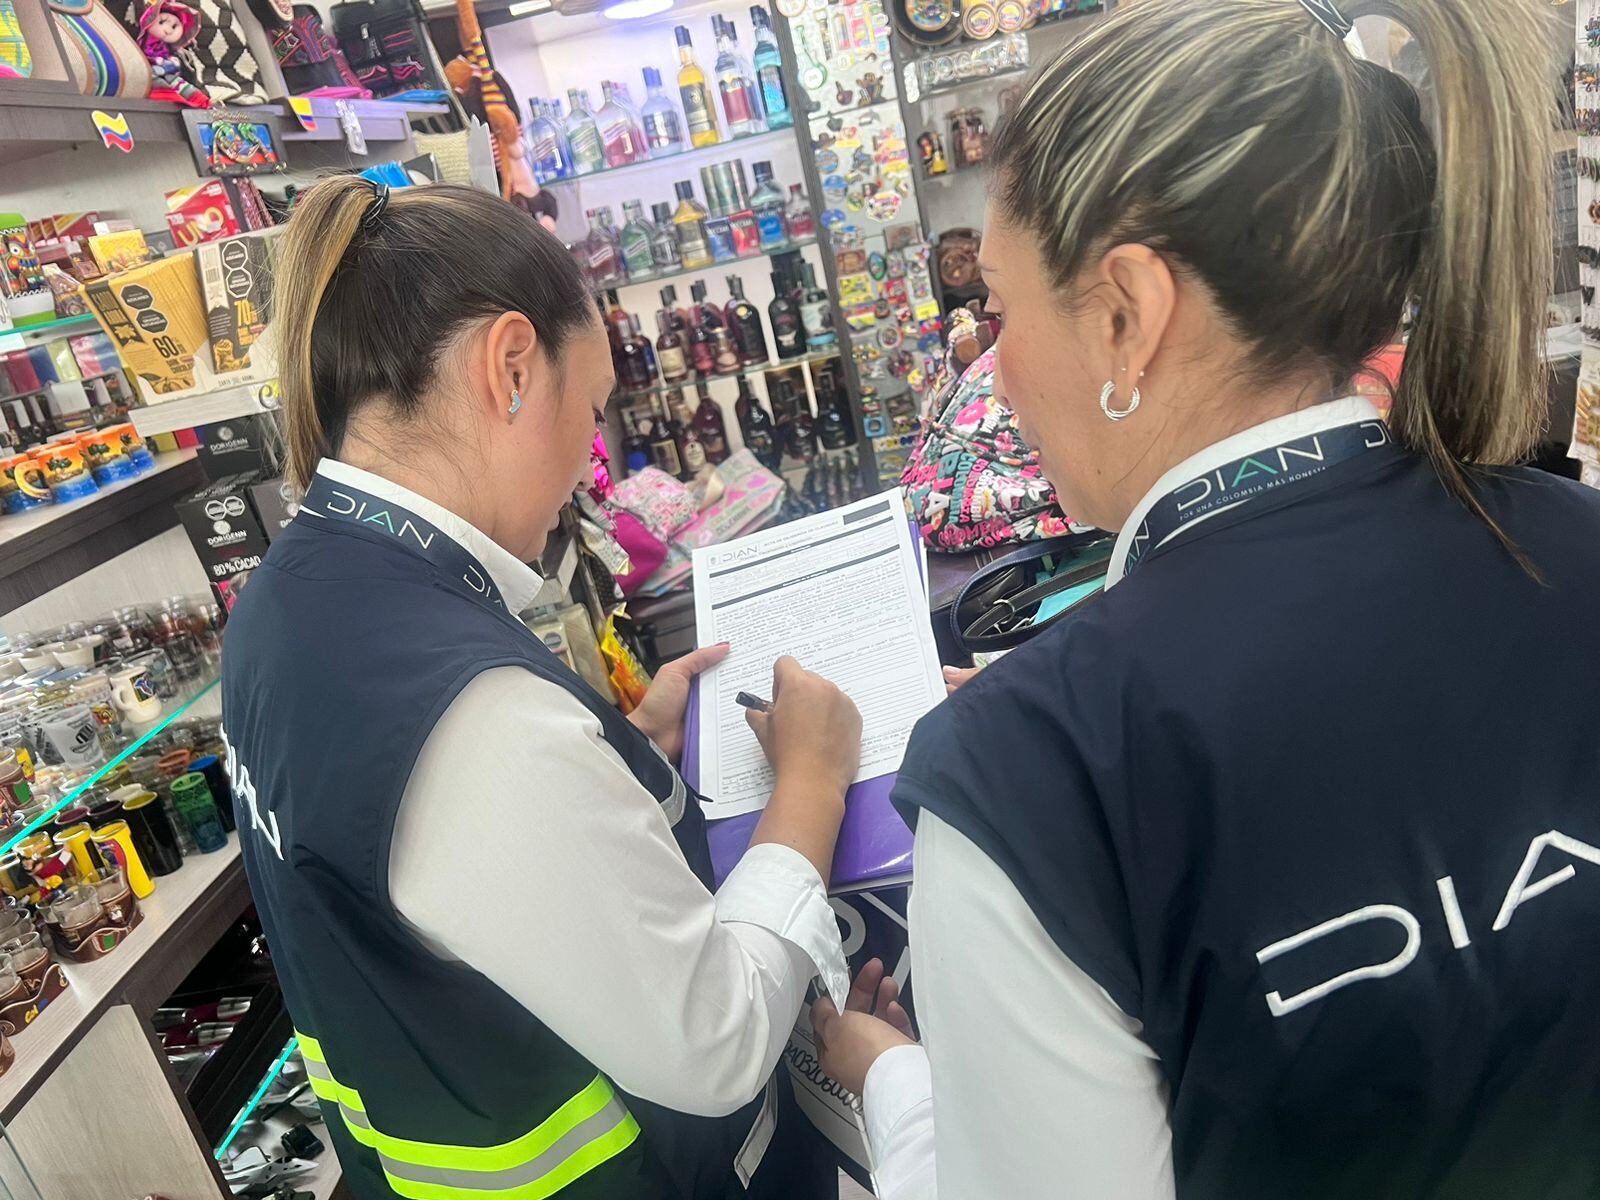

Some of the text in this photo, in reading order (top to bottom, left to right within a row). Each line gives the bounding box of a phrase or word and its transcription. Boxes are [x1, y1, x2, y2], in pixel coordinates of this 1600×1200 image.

[1173, 436, 1325, 512] DIAN
[1179, 510, 1194, 522] POR
[1196, 502, 1213, 514] UNA
[1216, 485, 1264, 505] COLOMBIA
[1289, 466, 1327, 484] HONESTA
[327, 490, 435, 550] DIAN
[722, 546, 759, 562] DIAN
